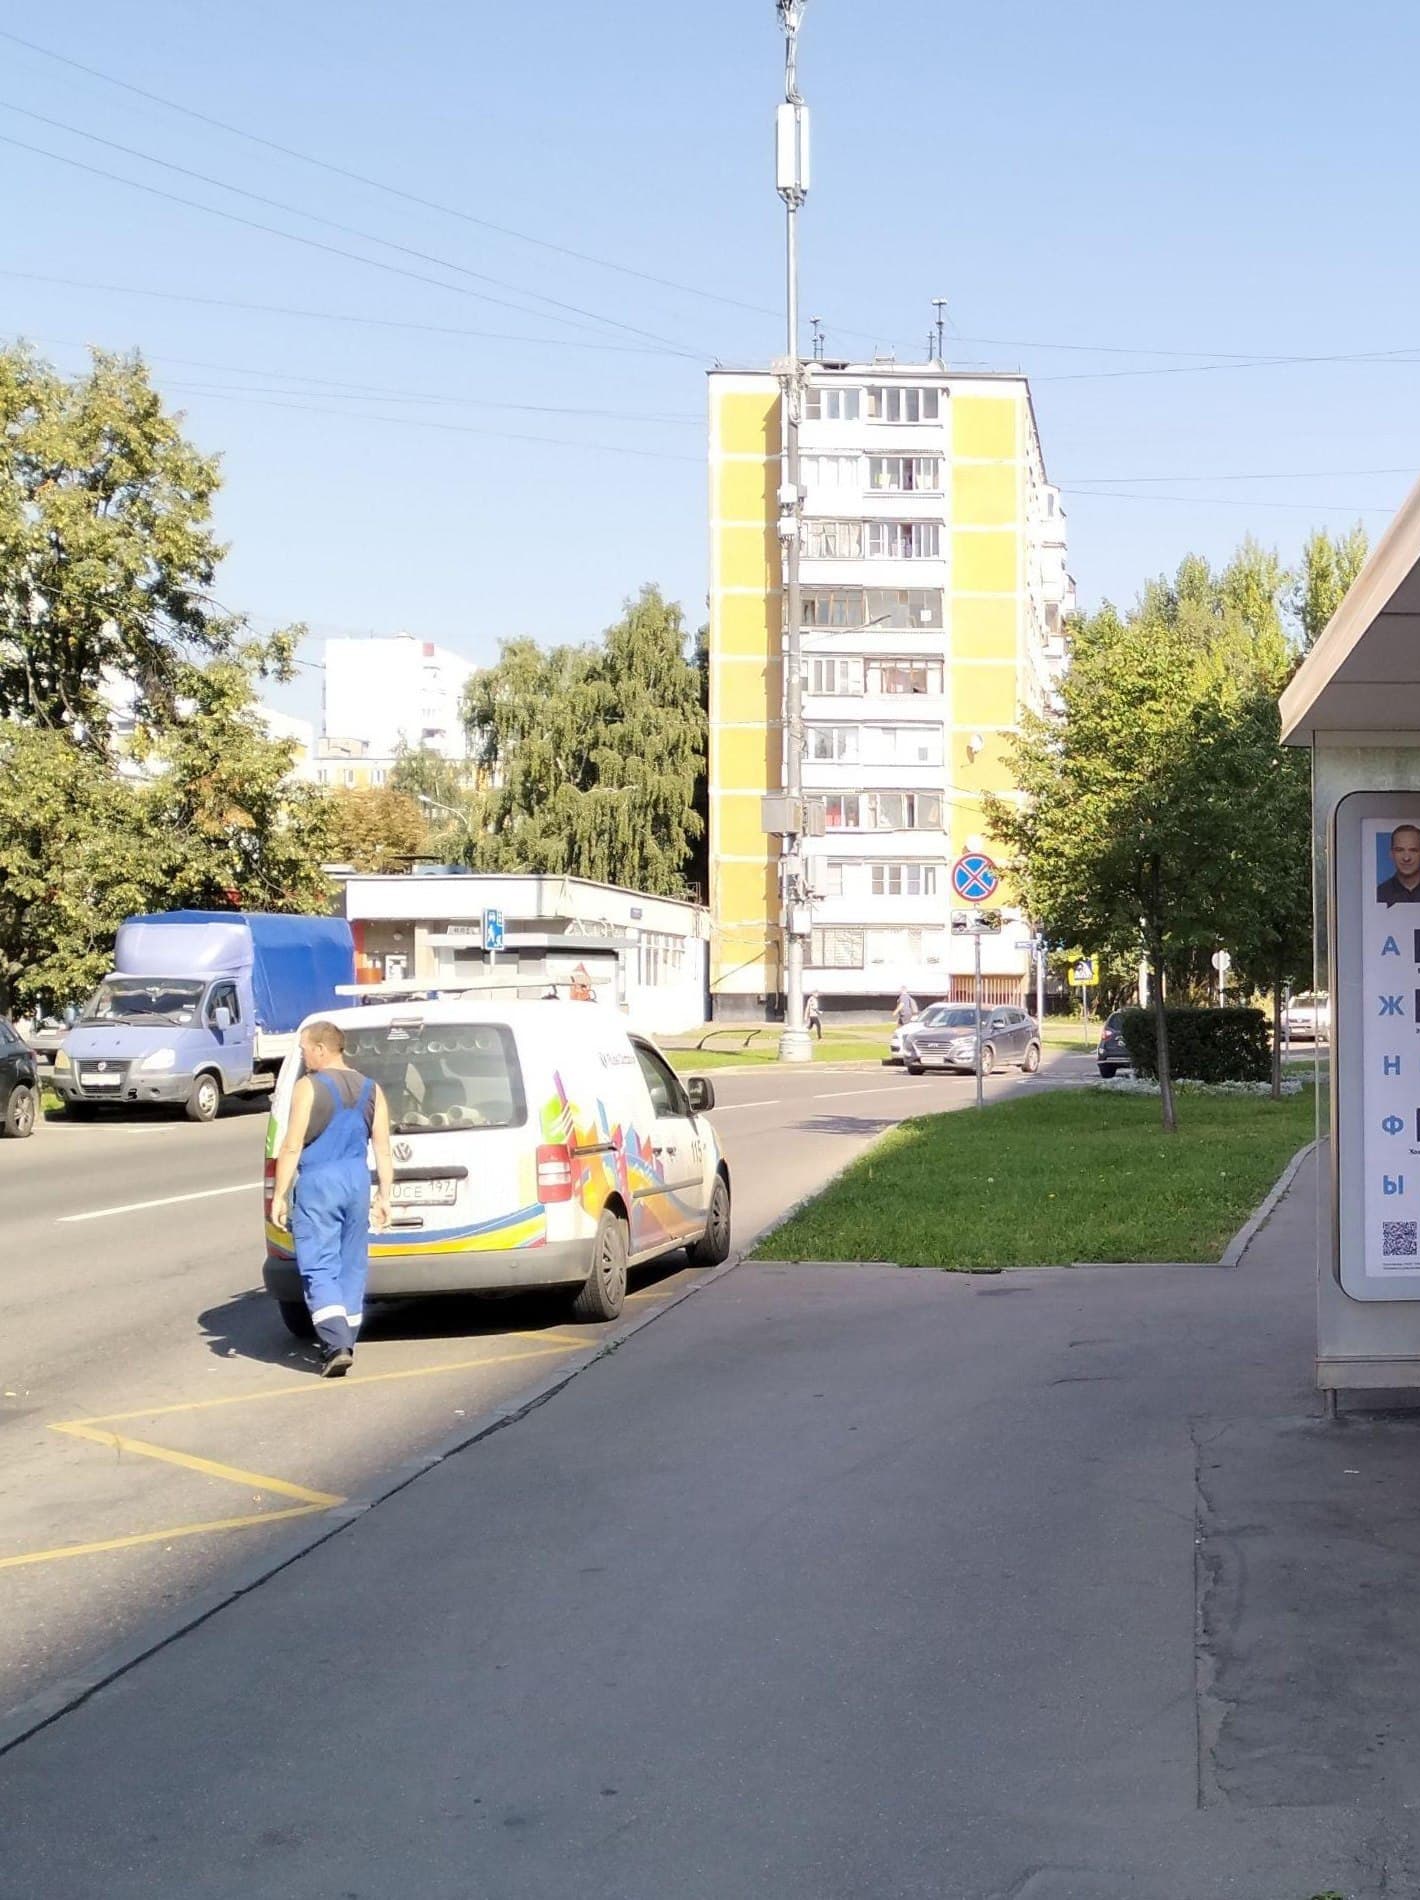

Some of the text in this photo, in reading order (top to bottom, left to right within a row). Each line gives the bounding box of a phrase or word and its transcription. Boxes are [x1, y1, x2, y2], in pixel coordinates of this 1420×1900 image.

[1380, 935, 1401, 956] А
[1378, 995, 1405, 1016] Ж
[1383, 1055, 1401, 1076] Н
[1381, 1114, 1404, 1136] Ф
[1382, 1174, 1404, 1196] Ы
